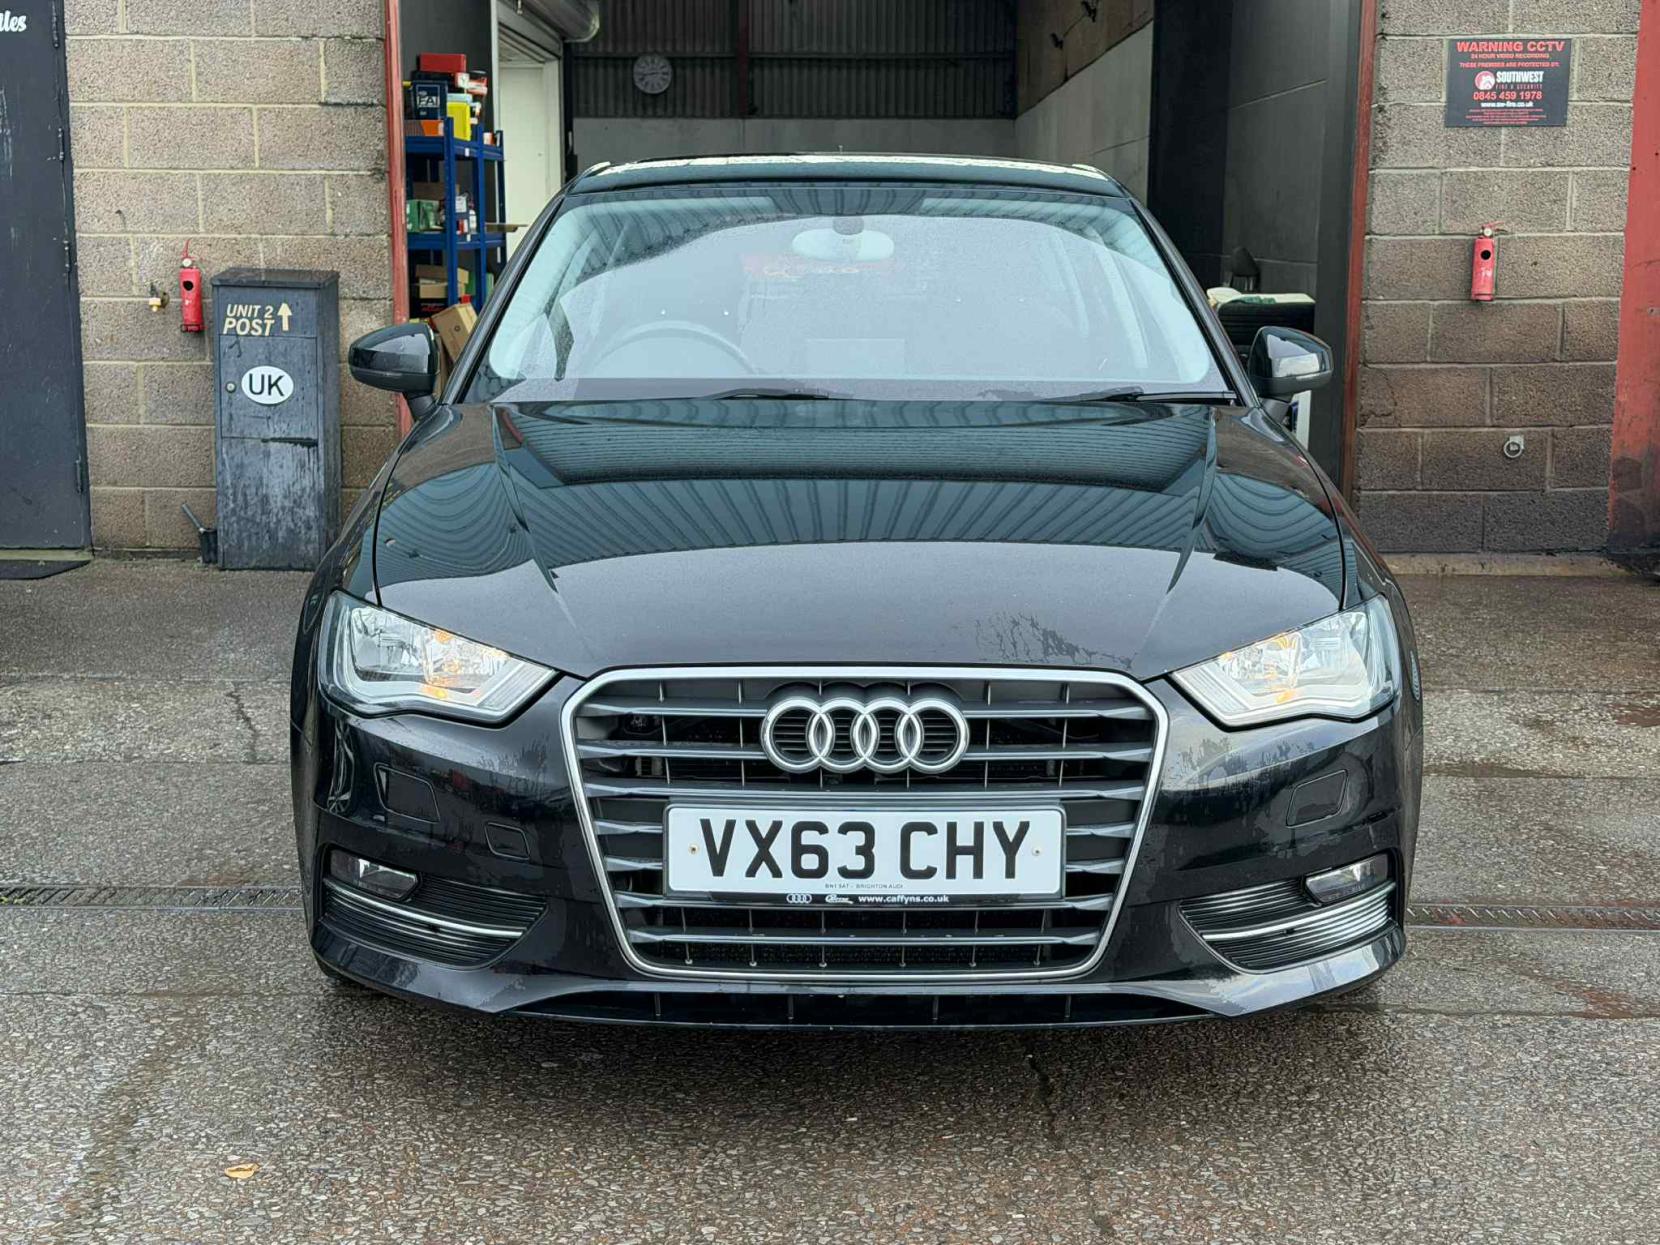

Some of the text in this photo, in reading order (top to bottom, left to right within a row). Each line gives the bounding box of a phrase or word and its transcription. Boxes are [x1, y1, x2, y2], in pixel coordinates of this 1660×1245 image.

[1456, 41, 1565, 52] WARNING CCTV
[1496, 70, 1544, 83] SOUTHWEST
[1473, 91, 1543, 100] 0845 459 1978
[226, 304, 274, 319] UNIT 2
[223, 317, 275, 336] POST
[249, 373, 285, 397] UK
[699, 818, 1031, 880] VX63 CHY
[858, 894, 950, 905] www.caffyns.co.uk
